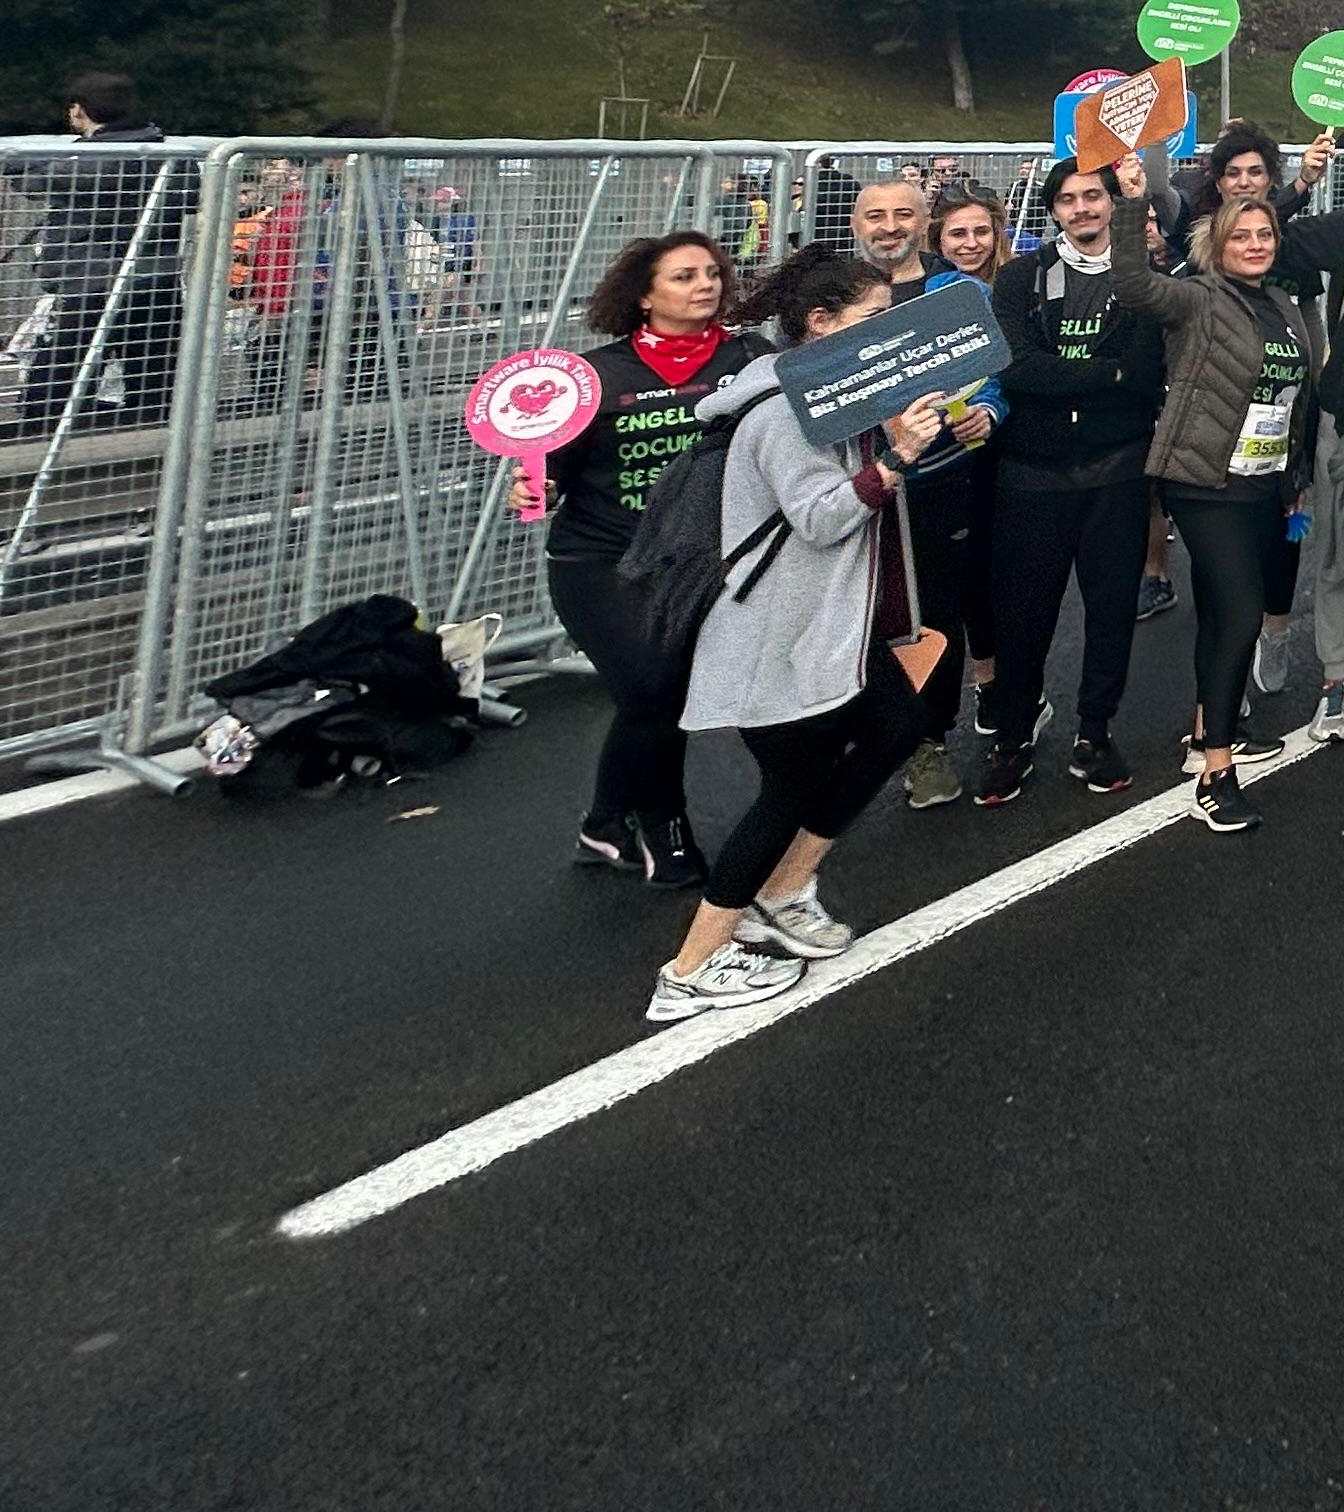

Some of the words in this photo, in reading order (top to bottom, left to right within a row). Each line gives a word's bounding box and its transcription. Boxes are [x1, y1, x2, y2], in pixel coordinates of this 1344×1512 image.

[472, 358, 531, 425] Smartware
[804, 355, 899, 404] Kahramanlar
[899, 342, 934, 363] Uçar
[808, 400, 838, 419] Biz
[837, 374, 905, 408] Koşmayı
[903, 351, 951, 379] Tercih
[618, 431, 703, 466] ÇOCUK
